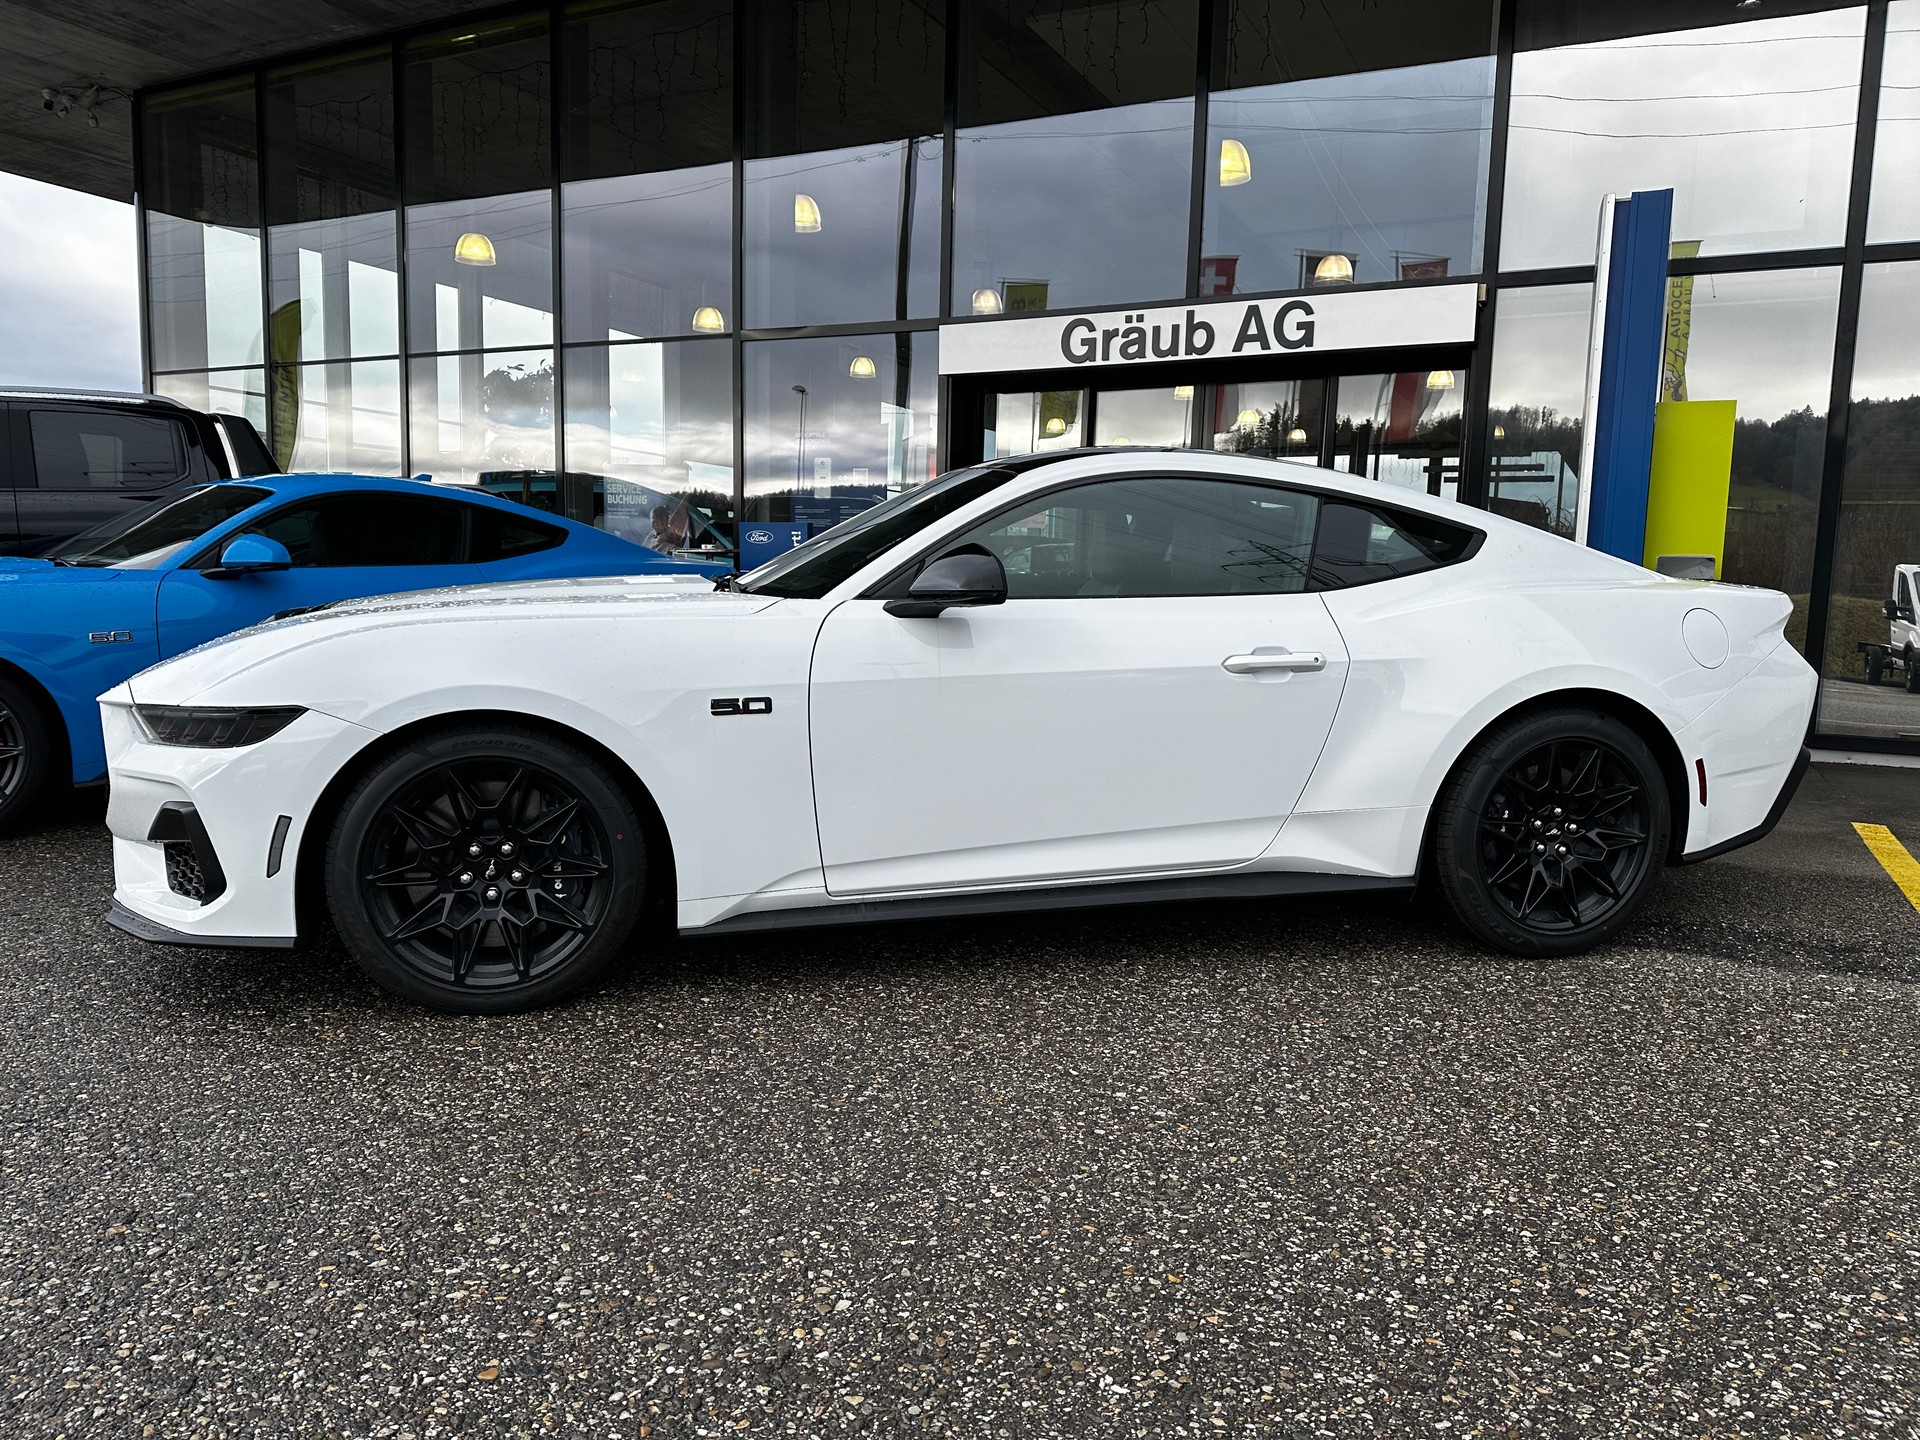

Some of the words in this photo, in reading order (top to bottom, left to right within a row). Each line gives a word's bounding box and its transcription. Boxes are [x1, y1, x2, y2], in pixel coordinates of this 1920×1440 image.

[1061, 309, 1215, 364] Gräub
[1232, 300, 1315, 352] AG
[607, 483, 642, 494] SERVICE
[607, 494, 648, 505] BUCHUNG
[749, 531, 770, 542] Ford
[711, 696, 772, 716] 5.0
